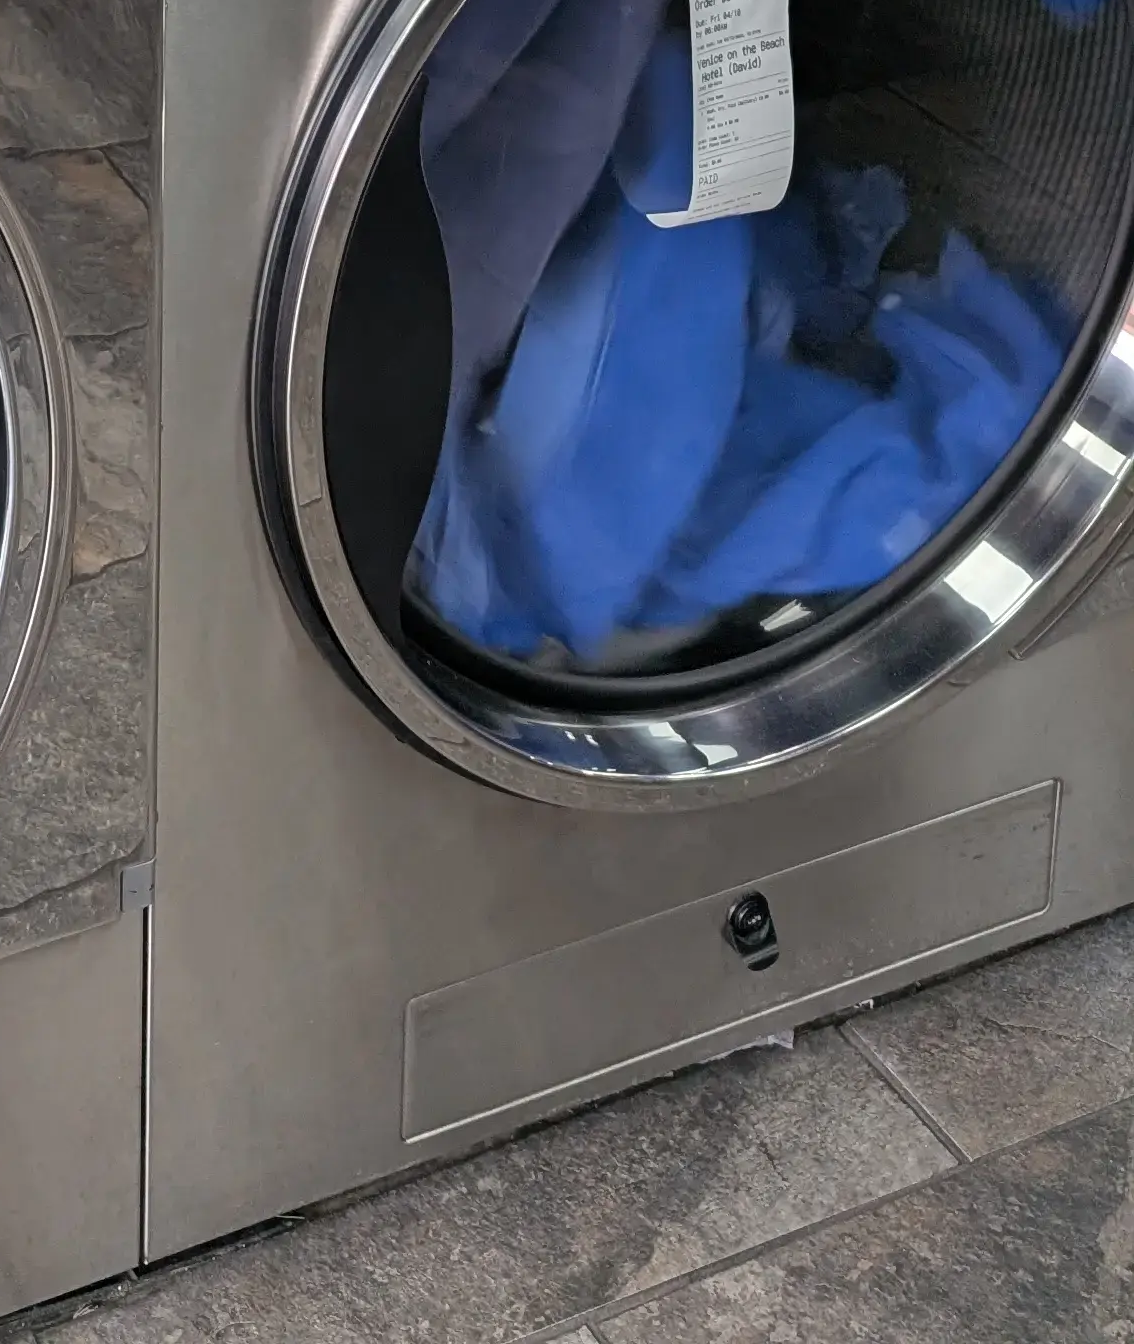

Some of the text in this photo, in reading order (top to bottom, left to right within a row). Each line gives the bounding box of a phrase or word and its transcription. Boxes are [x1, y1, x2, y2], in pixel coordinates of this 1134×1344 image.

[695, 19, 707, 29] Due:
[710, 14, 720, 23] Fri
[697, 53, 723, 70] Venice
[727, 50, 738, 60] on
[742, 44, 757, 56] the
[760, 36, 785, 52] Beach
[701, 56, 762, 83] Hotel (David)
[698, 173, 719, 188] PAID
